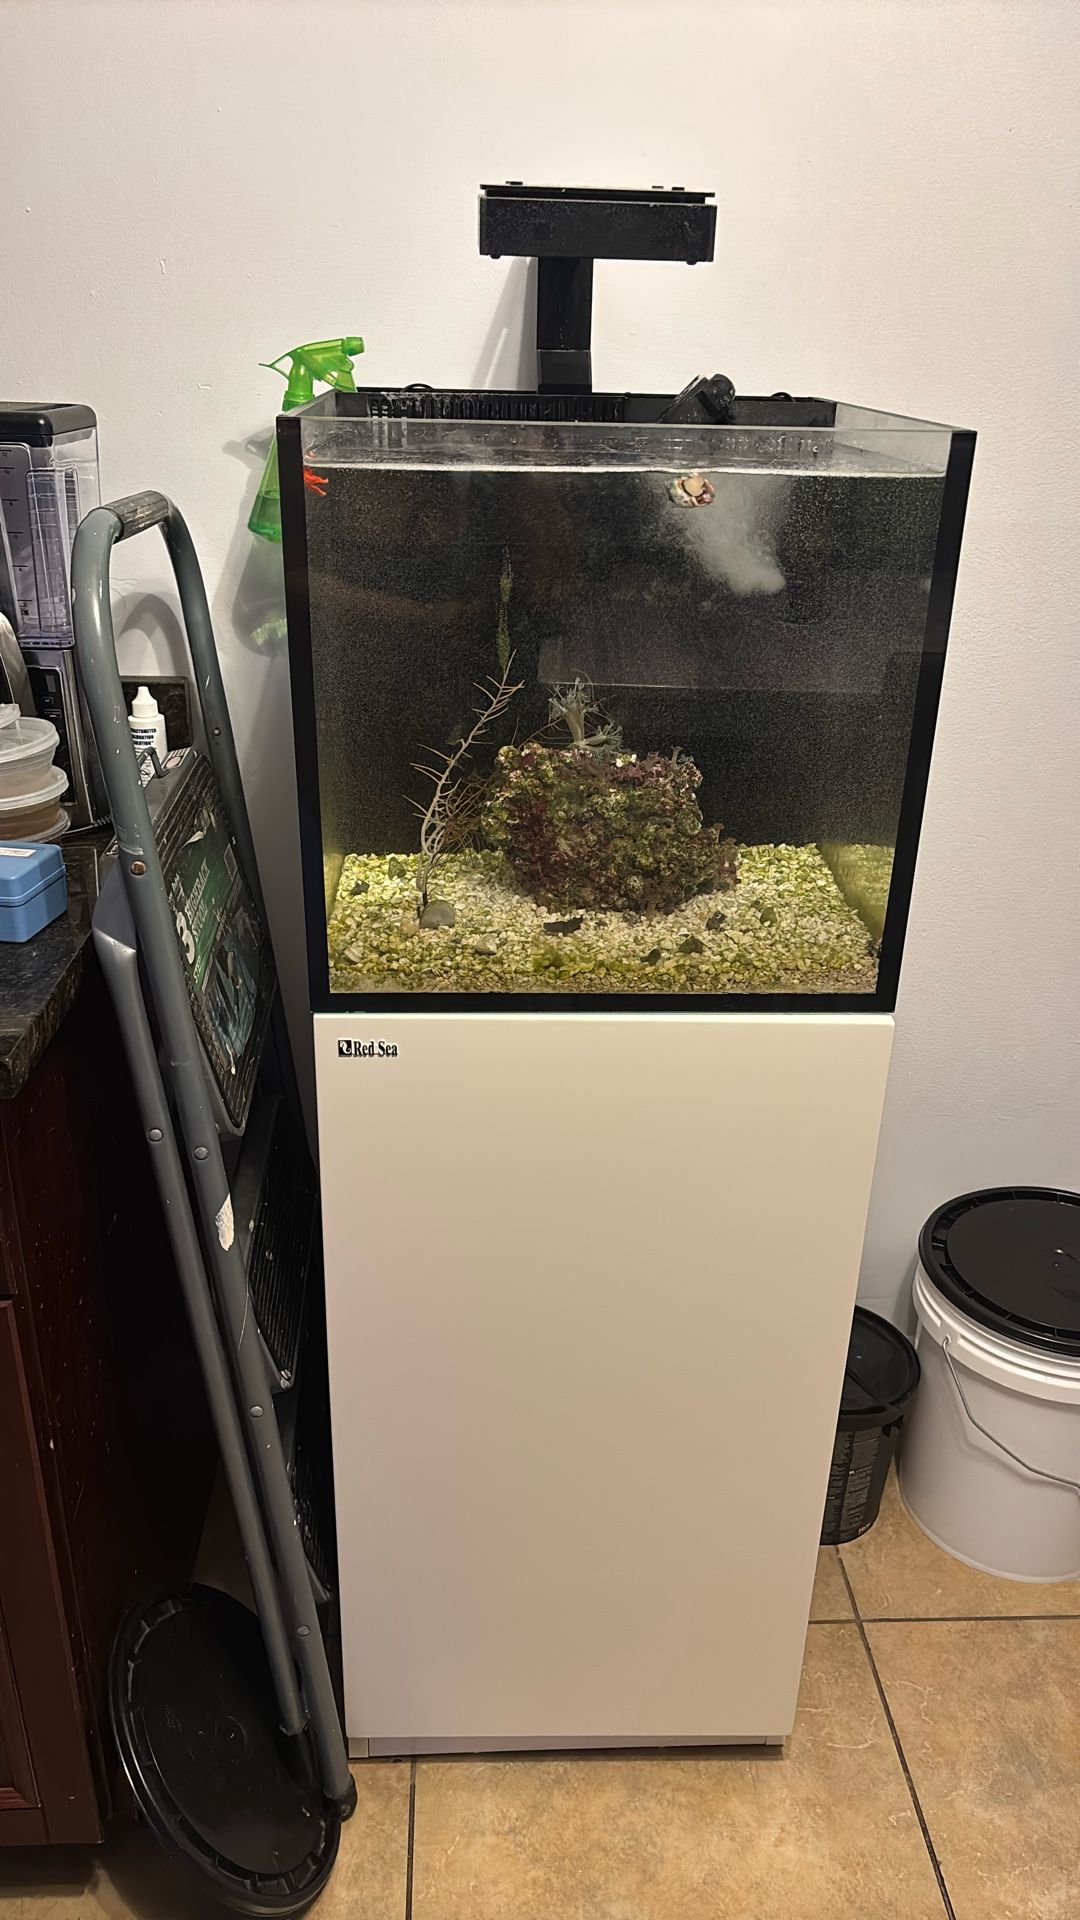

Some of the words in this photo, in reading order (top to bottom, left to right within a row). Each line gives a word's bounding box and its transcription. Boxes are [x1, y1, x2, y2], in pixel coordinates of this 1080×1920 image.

[176, 911, 195, 964] 3
[192, 898, 208, 944] STOOL
[353, 1041, 374, 1057] Red
[378, 1041, 398, 1057] Sea
